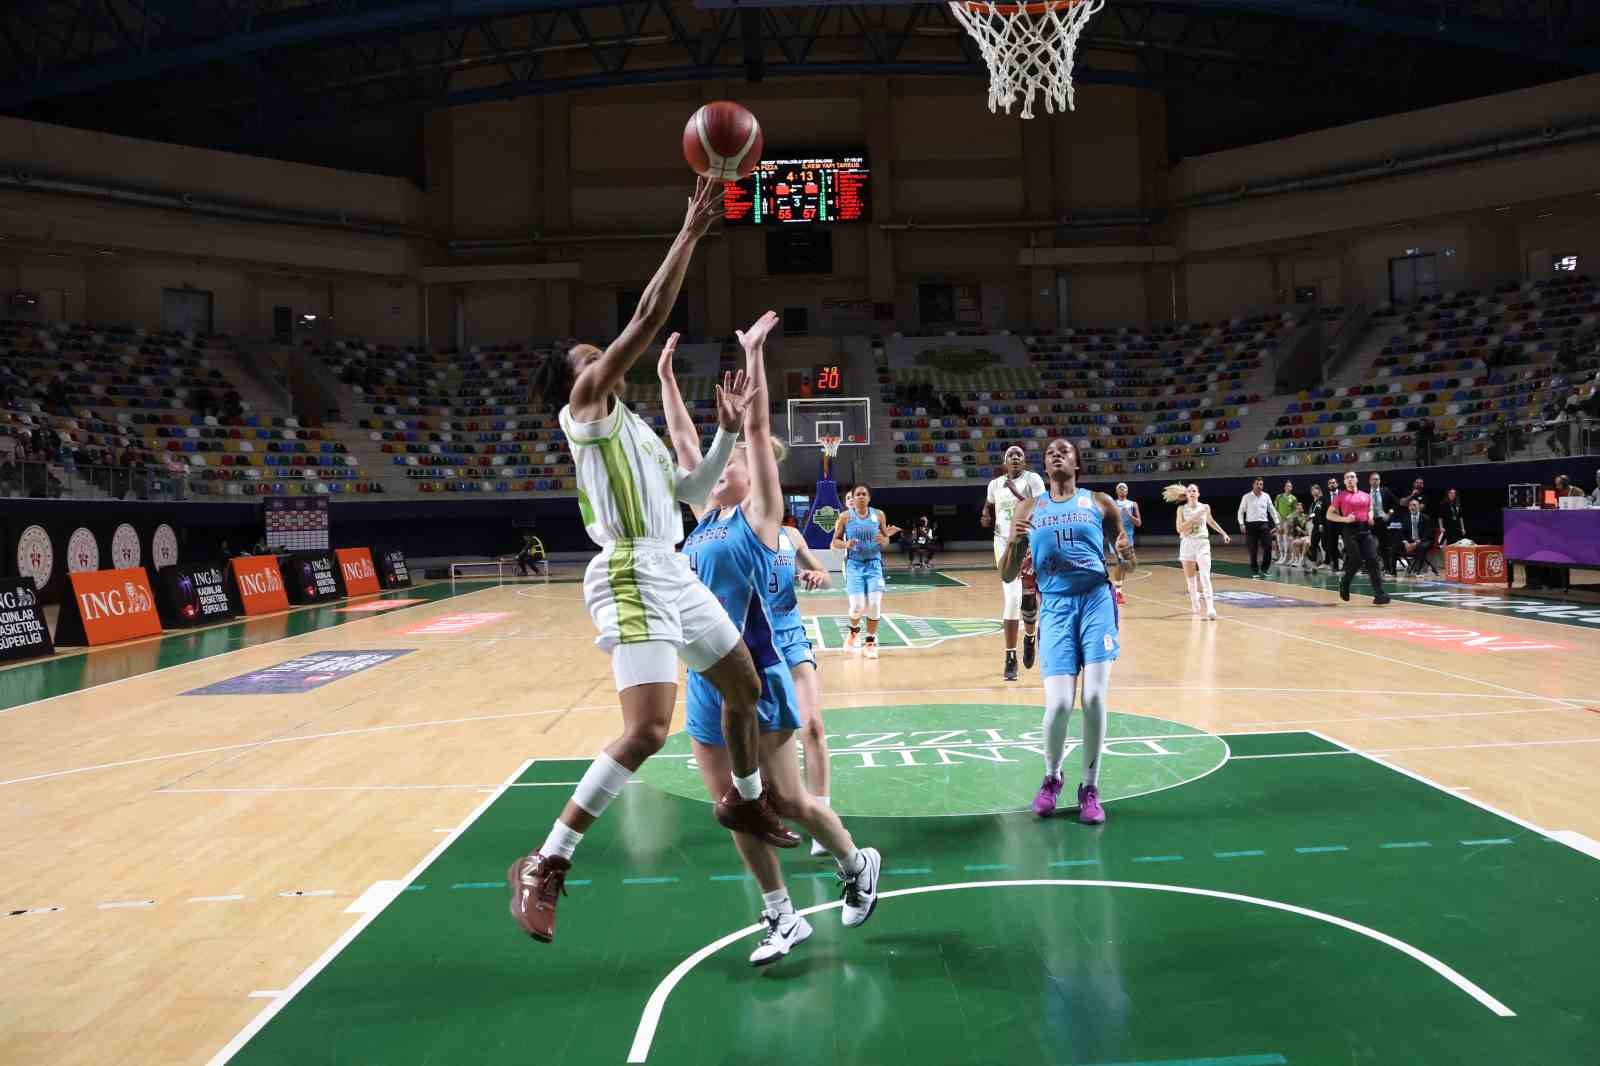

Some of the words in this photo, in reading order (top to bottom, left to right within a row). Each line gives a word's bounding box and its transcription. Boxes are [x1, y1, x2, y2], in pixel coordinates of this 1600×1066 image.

[793, 198, 801, 207] 3
[817, 372, 840, 389] 20
[1054, 527, 1074, 550] 14
[193, 572, 212, 586] ING
[343, 561, 363, 581] ING
[240, 572, 267, 596] ING
[768, 572, 779, 594] 9
[80, 589, 126, 620] ING
[0, 620, 44, 637] ASKETBOL
